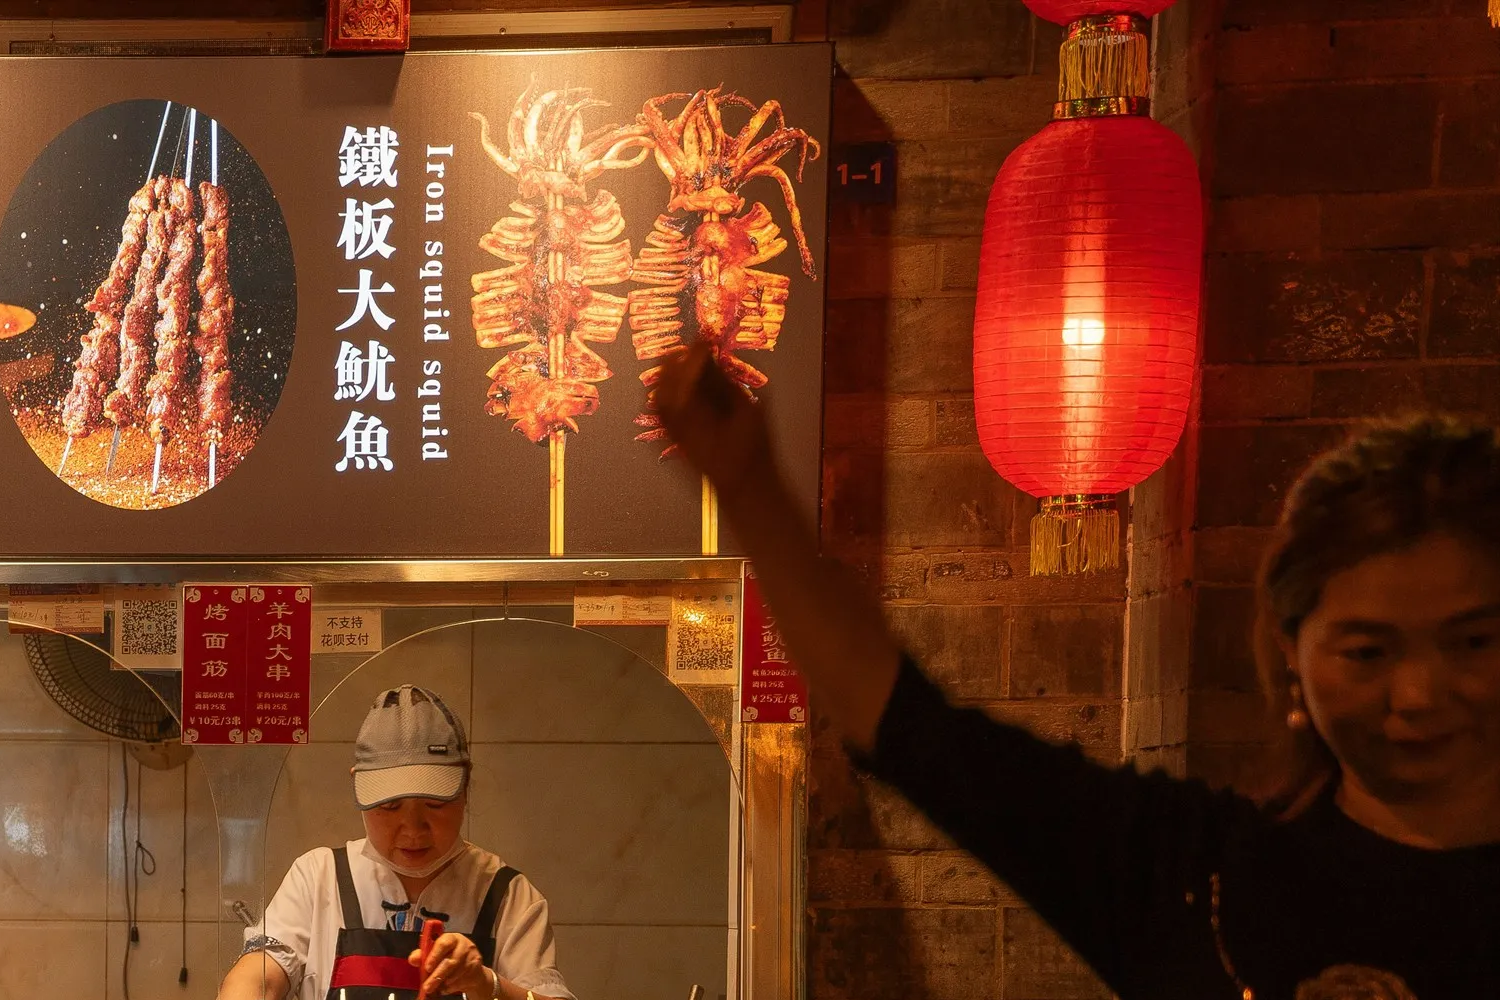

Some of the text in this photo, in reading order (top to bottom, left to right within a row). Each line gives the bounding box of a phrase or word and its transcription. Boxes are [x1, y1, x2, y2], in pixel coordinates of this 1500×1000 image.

[837, 163, 881, 185] 1-1
[334, 125, 399, 472] 鐵板大魷魚
[417, 144, 453, 461] Iron squid squid
[201, 603, 230, 677] 烤面筋
[265, 601, 294, 682] 羊肉大串
[321, 632, 370, 647] 花呗支付
[326, 615, 364, 630] 不支持
